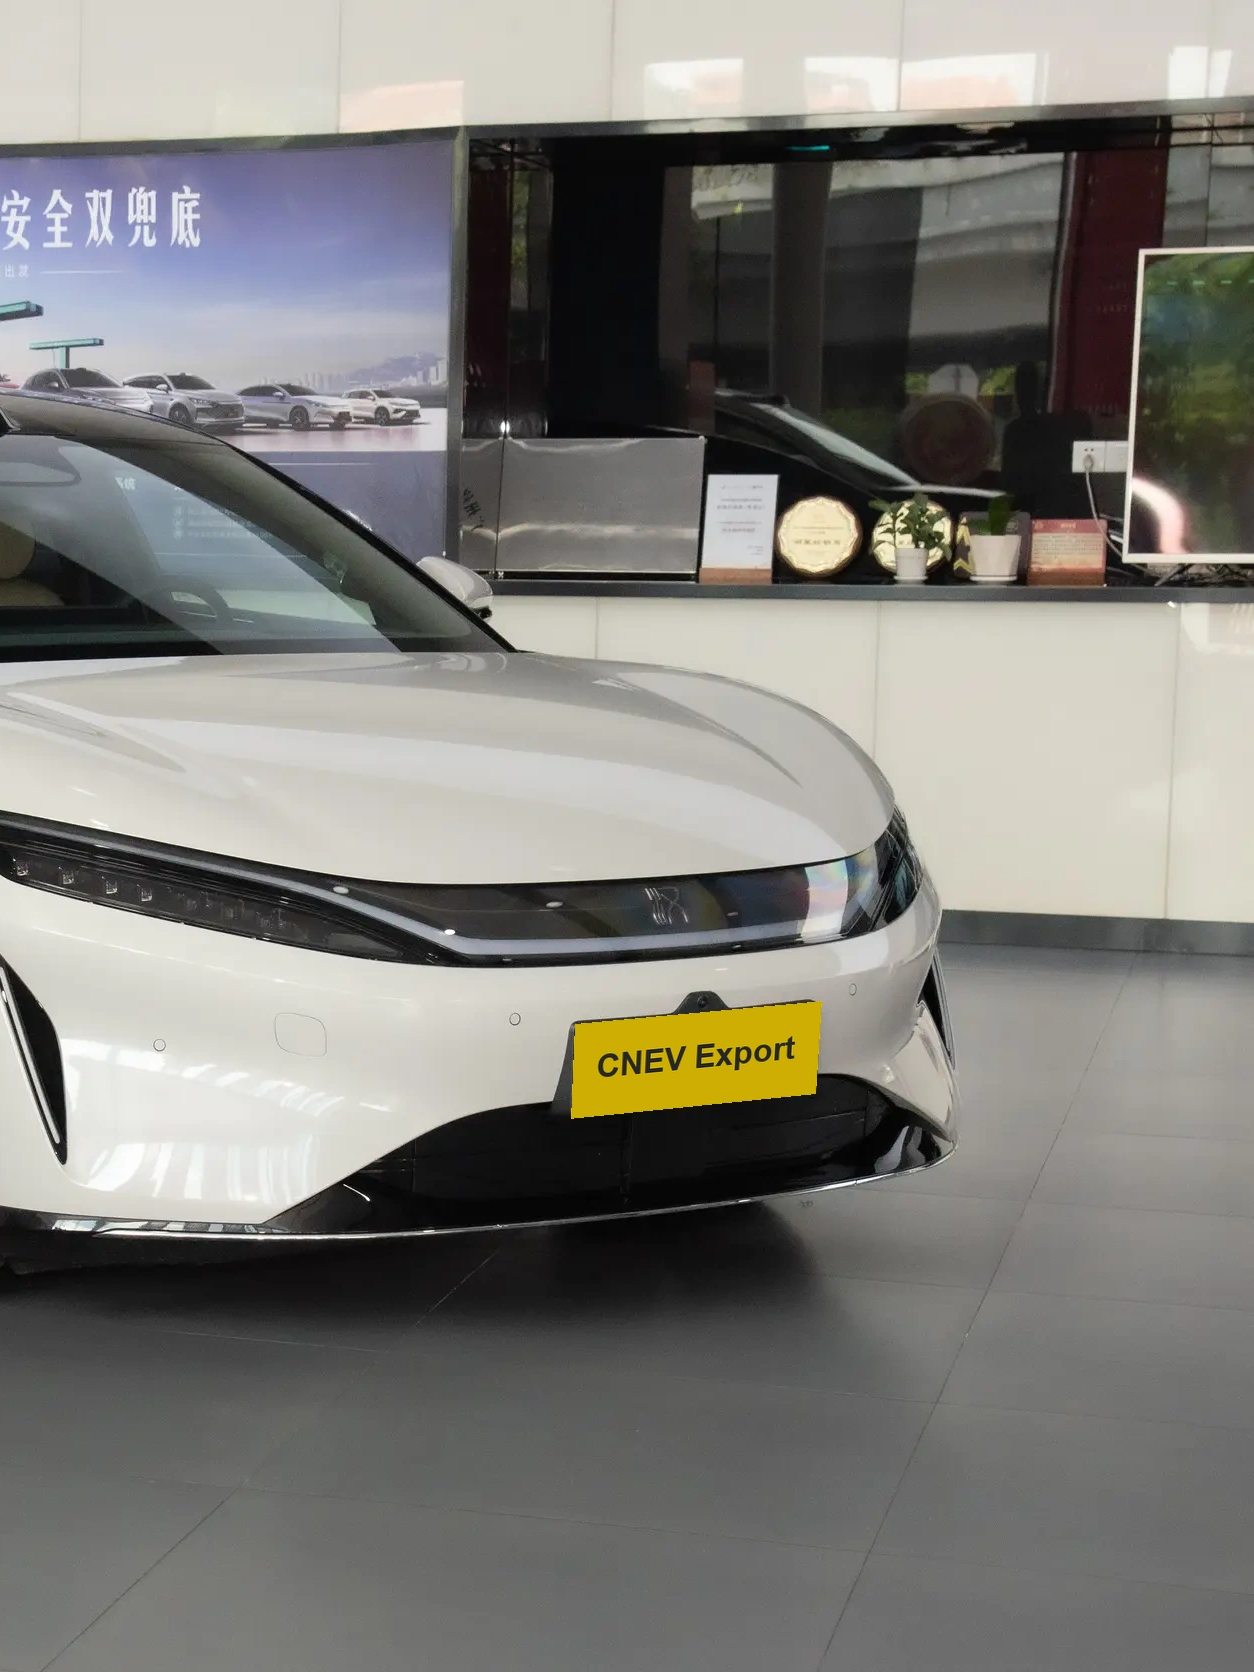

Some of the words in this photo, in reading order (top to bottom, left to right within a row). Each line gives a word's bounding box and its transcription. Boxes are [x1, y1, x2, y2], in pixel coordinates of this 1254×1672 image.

[1, 185, 202, 250] 安全双兜底
[597, 1046, 686, 1077] CNEV
[695, 1036, 796, 1070] Export
